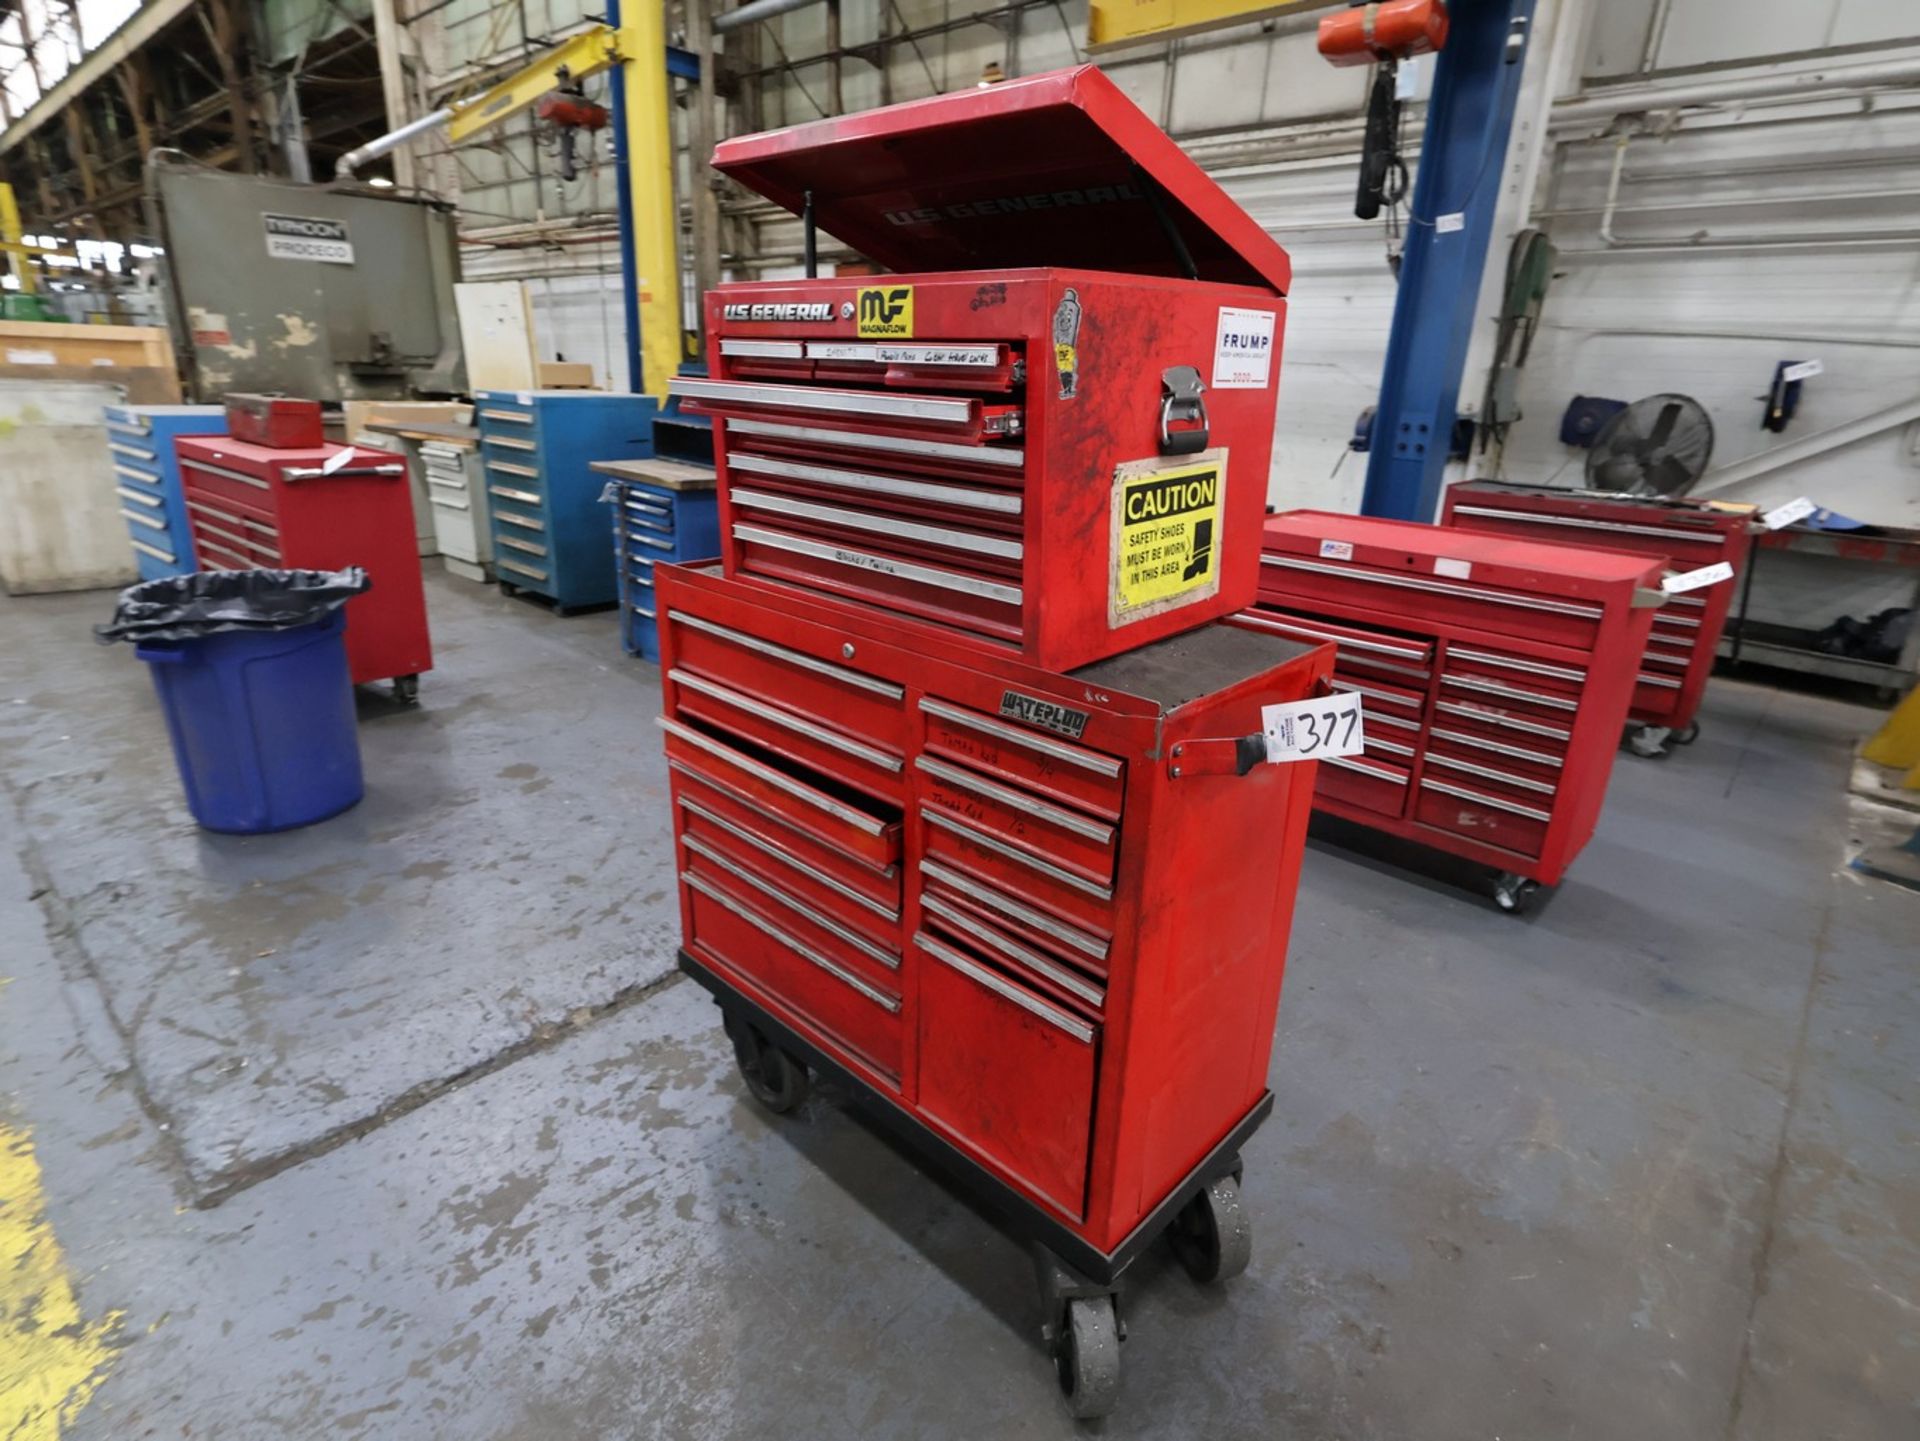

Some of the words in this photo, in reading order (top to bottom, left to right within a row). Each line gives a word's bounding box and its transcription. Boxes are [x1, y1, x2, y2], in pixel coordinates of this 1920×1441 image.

[949, 184, 1144, 218] GENERAL
[751, 303, 834, 321] GENERAL
[860, 324, 907, 334] MAGNAFLOW
[1127, 478, 1214, 520] CAUTION
[1129, 528, 1159, 547] SAFETY
[1160, 522, 1185, 540] SHOES
[1126, 550, 1150, 567] MUST
[1151, 546, 1162, 560] BE
[1164, 541, 1186, 558] WORN
[1130, 571, 1140, 586] IN
[1142, 566, 1159, 582] THIS
[1161, 561, 1180, 576] AREA
[1298, 708, 1357, 754] 377
